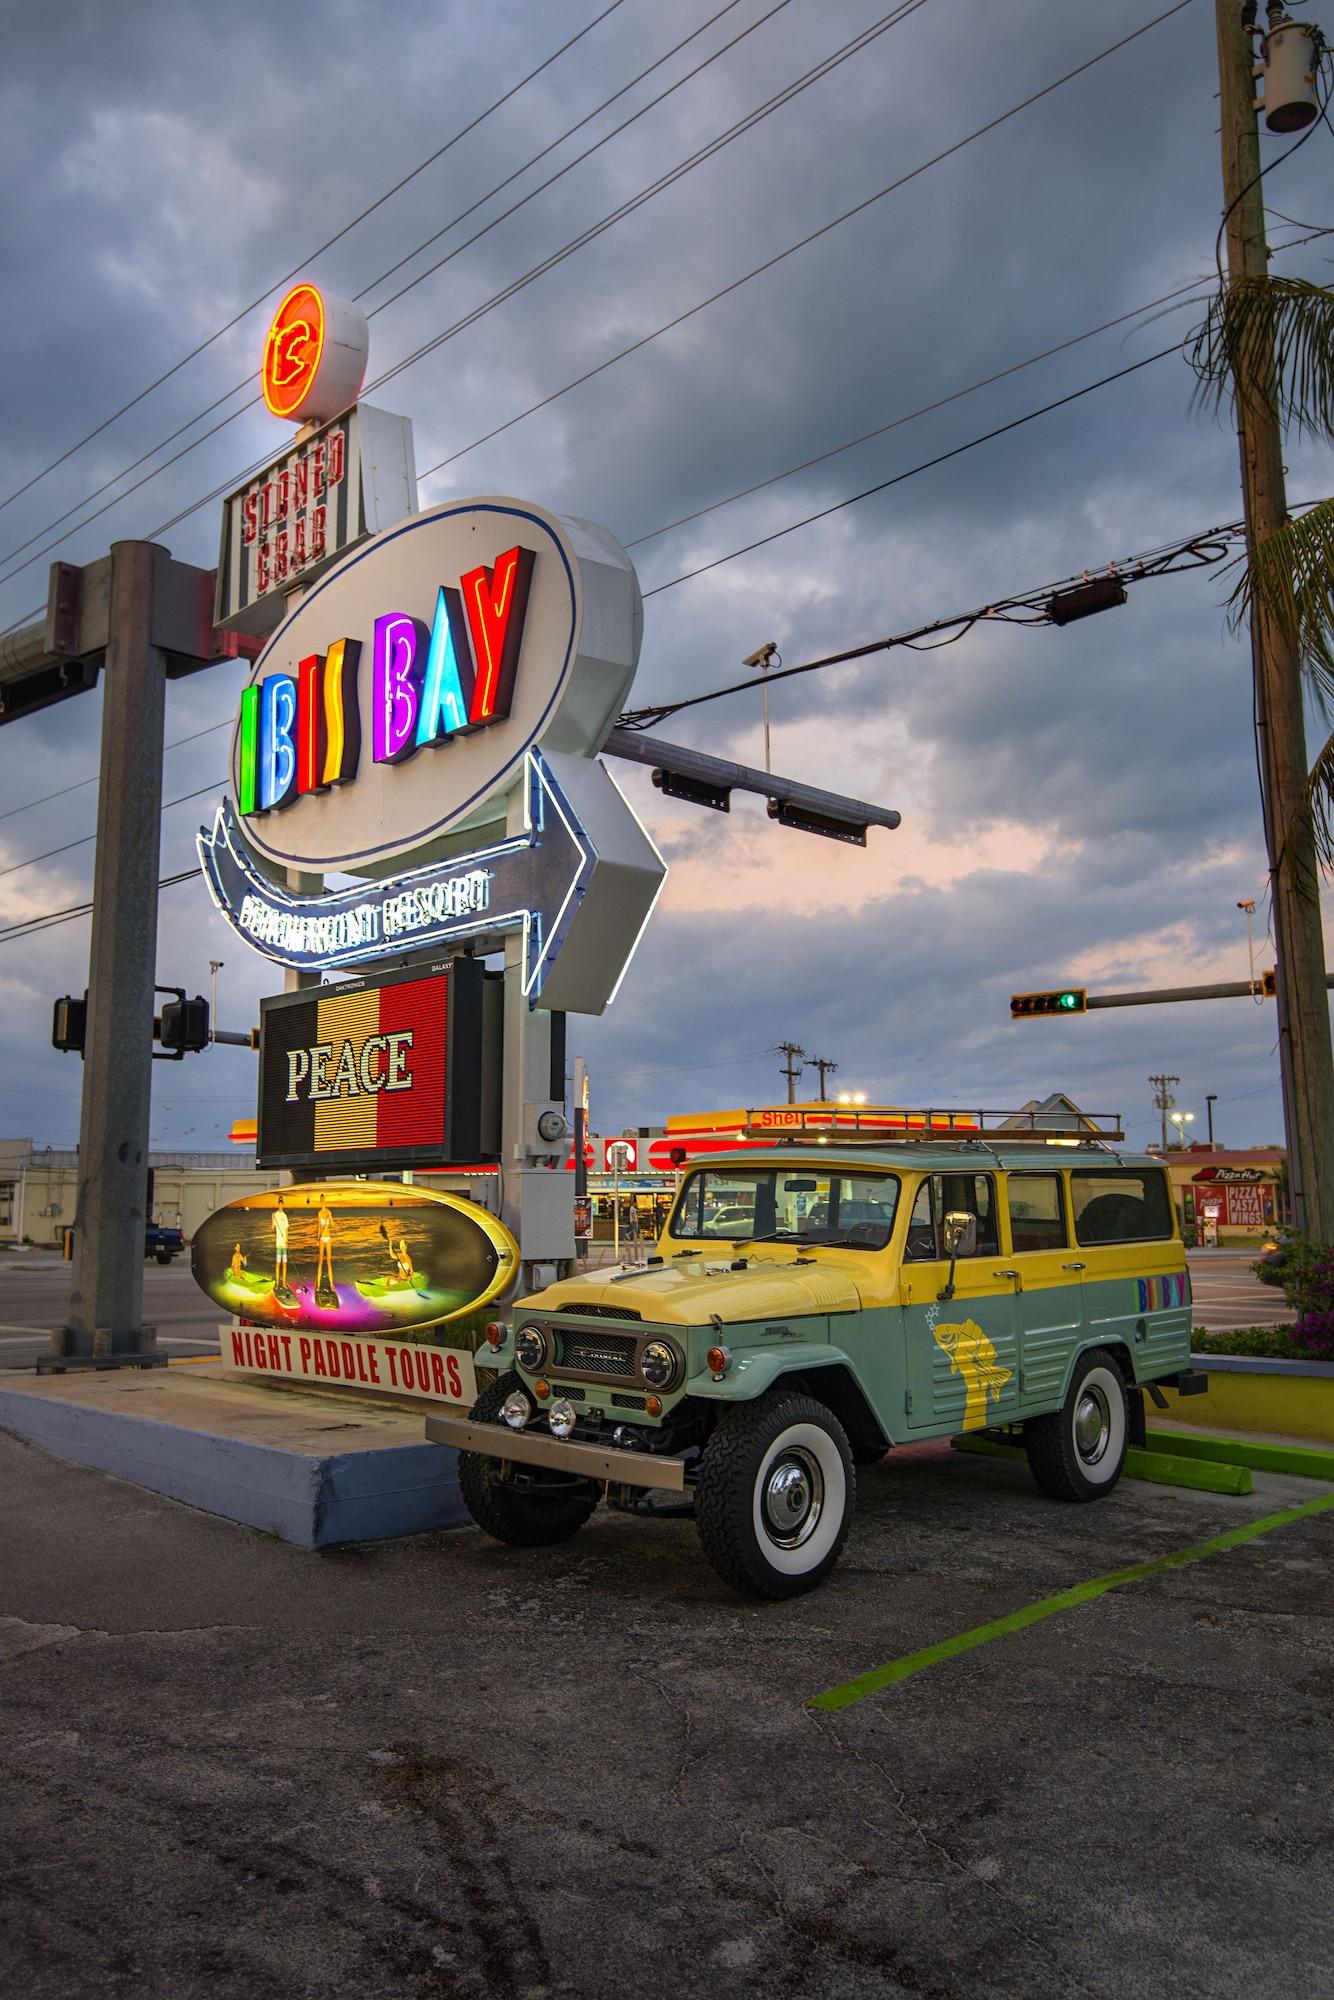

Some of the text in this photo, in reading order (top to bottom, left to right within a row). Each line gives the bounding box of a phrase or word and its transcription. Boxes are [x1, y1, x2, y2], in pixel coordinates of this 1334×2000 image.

[243, 431, 345, 547] STONED
[257, 504, 328, 593] CRAB
[239, 546, 528, 817] IBIS BAY
[382, 870, 490, 936] RESORT
[431, 962, 454, 972] GALAXY
[285, 1031, 414, 1102] PEACE
[763, 1111, 804, 1126] Shel
[1215, 1168, 1263, 1180] Pizza Hut
[1229, 1186, 1258, 1200] PIZZA
[1229, 1199, 1259, 1212] PASTA
[1231, 1211, 1261, 1225] WINGS
[1160, 1273, 1185, 1310] BAY
[230, 1331, 463, 1398] NIGHT PADDLE TOURS
